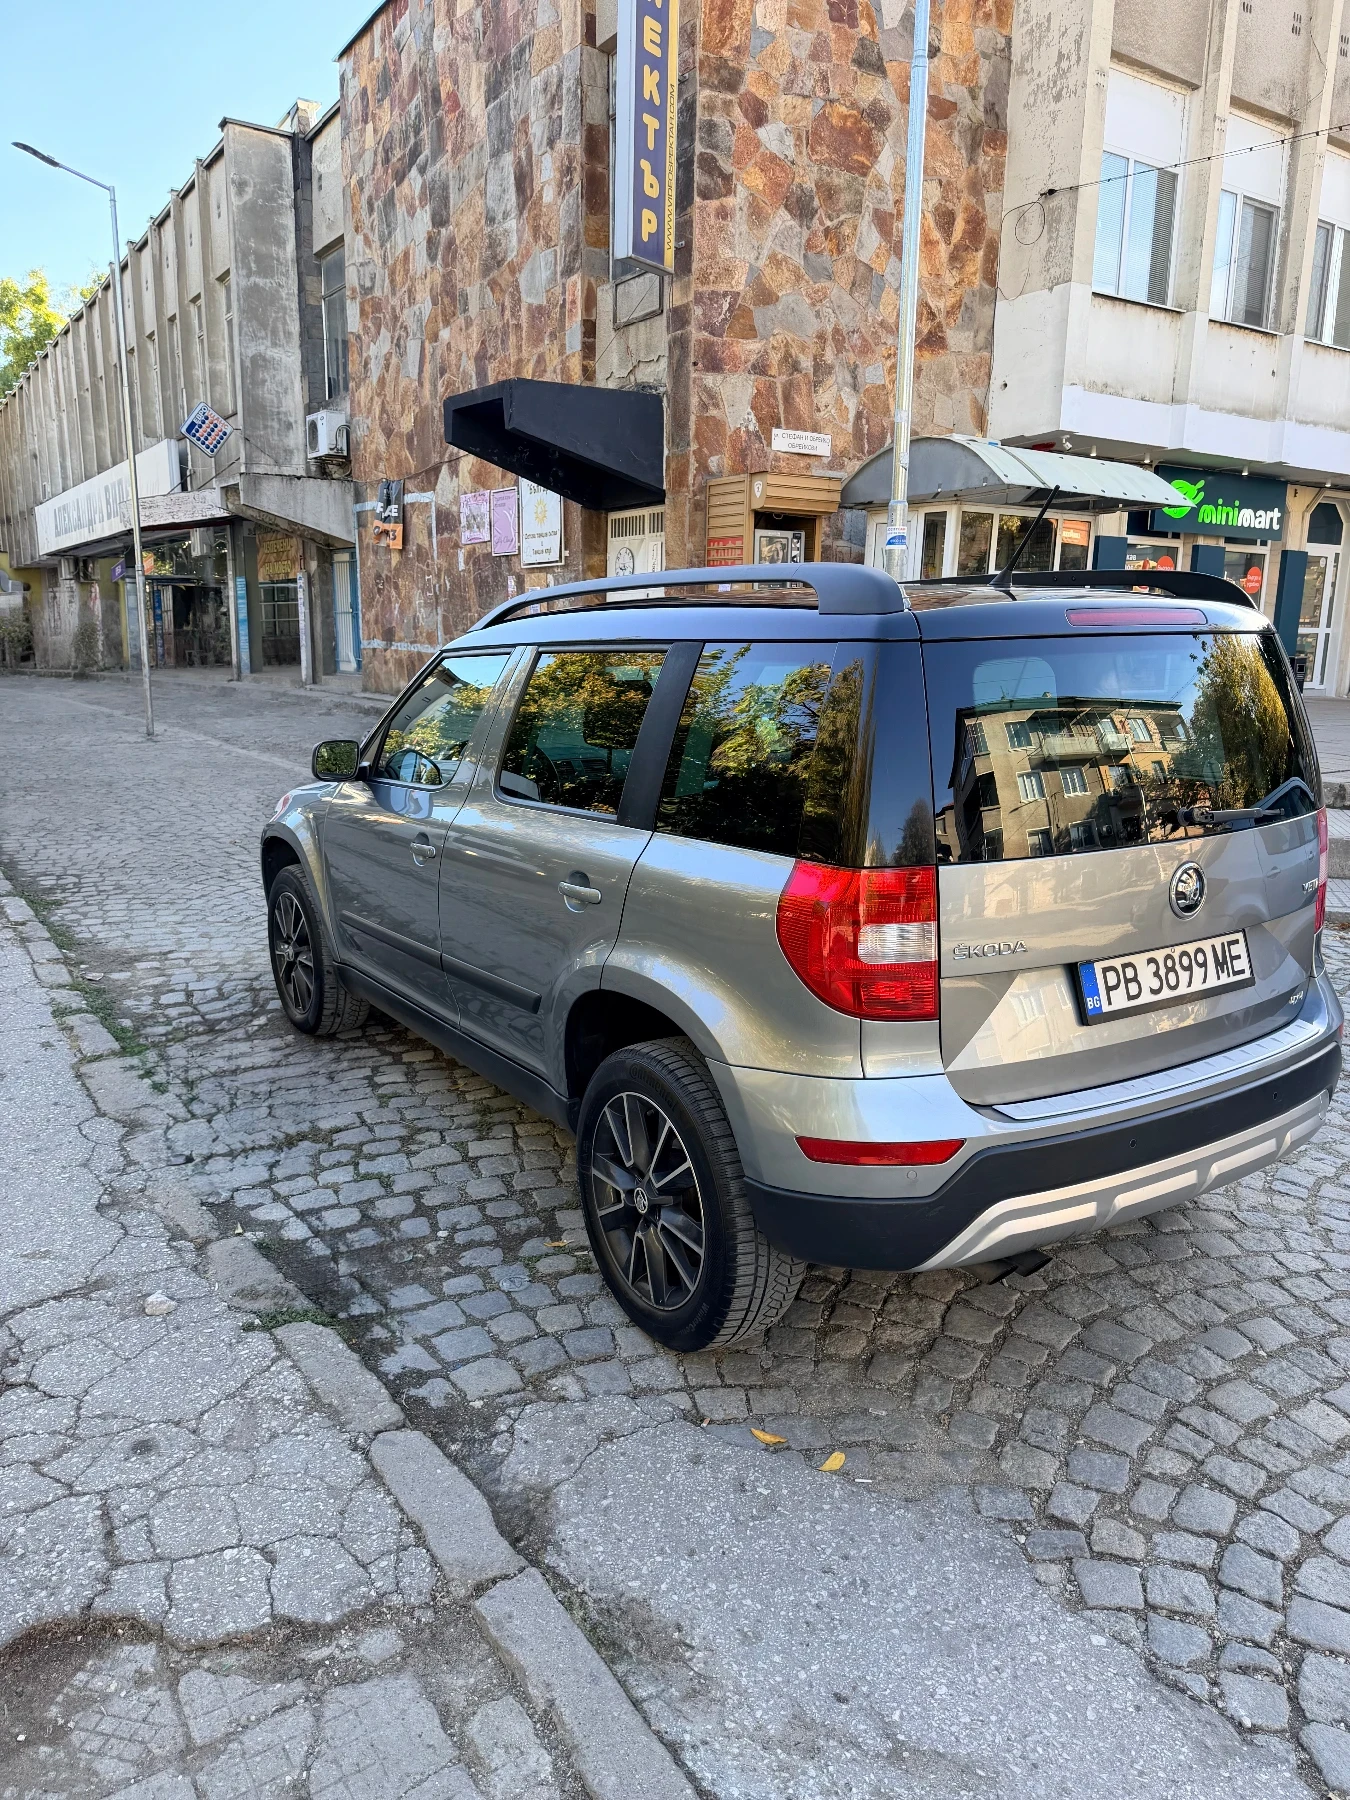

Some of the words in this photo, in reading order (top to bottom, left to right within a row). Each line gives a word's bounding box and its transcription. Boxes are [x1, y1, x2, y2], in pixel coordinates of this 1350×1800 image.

[640, 0, 662, 243] ЕКТЪР
[781, 432, 804, 441] СТЕФАН
[809, 435, 831, 444] ОБРЕЙКО
[788, 442, 818, 452] ОБРЕЙКОВИ
[54, 491, 105, 538] АЛЕКСАНДРА
[1198, 498, 1281, 531] minimart
[953, 940, 1028, 960] ŠKODA
[1101, 961, 1143, 1007] PB
[1146, 947, 1208, 996] 3899
[1210, 938, 1246, 981] ME
[1087, 995, 1101, 1010] BG
